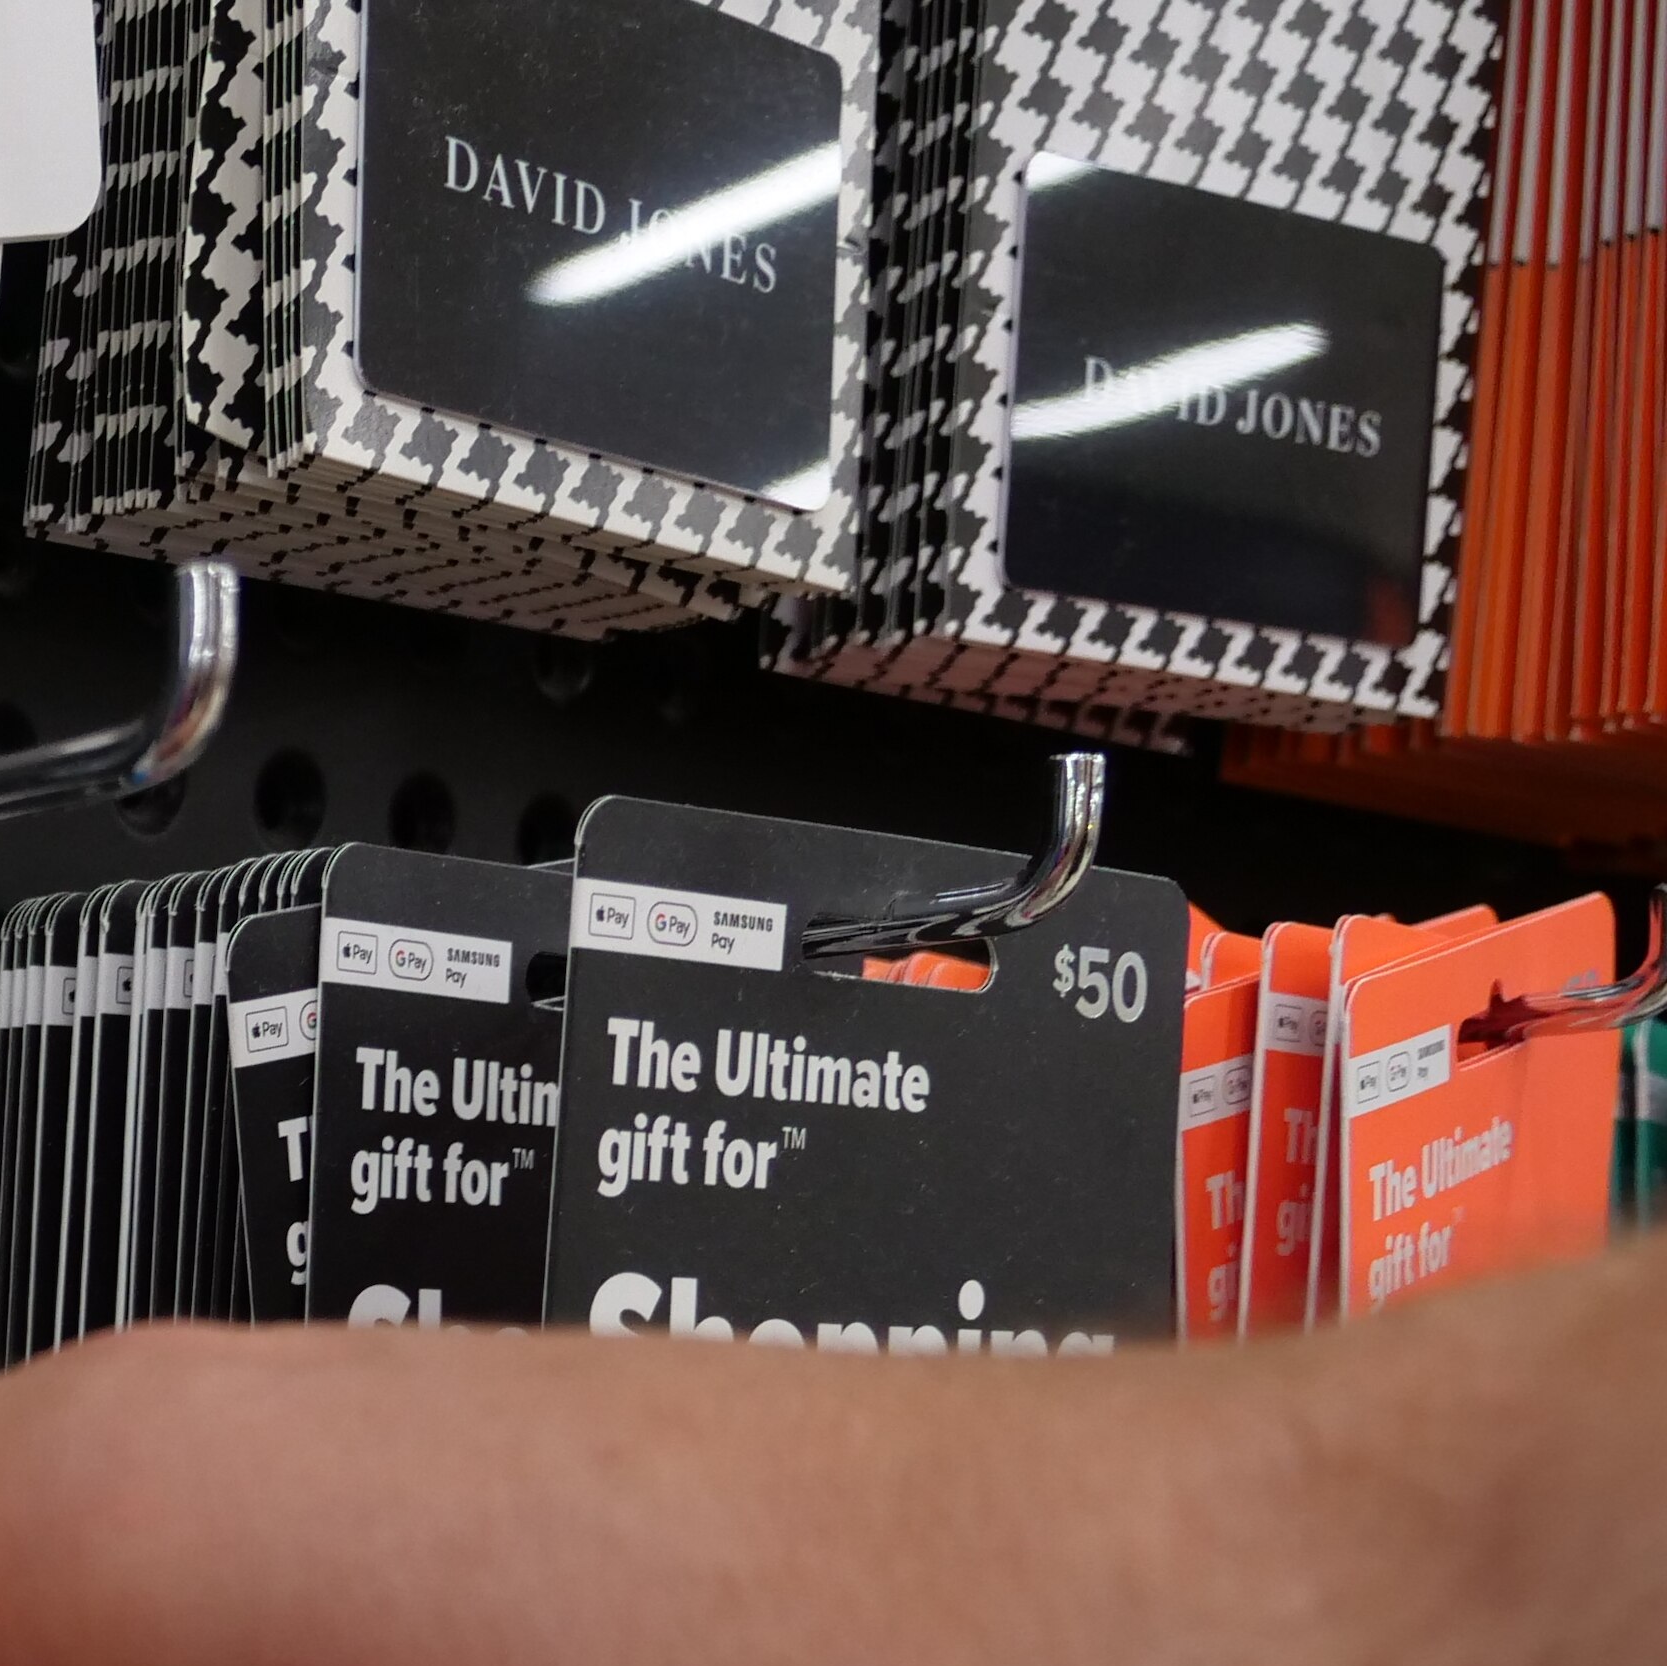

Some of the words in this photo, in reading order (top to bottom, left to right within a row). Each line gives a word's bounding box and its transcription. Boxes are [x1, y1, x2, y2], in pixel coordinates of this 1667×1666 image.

[443, 135, 606, 235] DAVID
[1084, 355, 1227, 428] DID
[1236, 391, 1383, 458] JONES
[606, 907, 630, 930] Pay
[668, 914, 691, 937] Pay
[710, 933, 736, 954] Pay
[712, 910, 774, 934] SAMSUNG
[352, 943, 373, 965] Pay
[407, 954, 427, 975] Pay
[445, 967, 468, 988] Pay
[446, 947, 501, 968] SAMSUNG
[1052, 944, 1148, 1023] $50
[261, 1019, 284, 1039] Pay
[356, 1047, 440, 1117] The
[607, 1016, 701, 1093] The
[714, 1028, 930, 1113] Ultimate
[597, 1113, 691, 1198] gift
[702, 1121, 777, 1190] for
[1284, 1107, 1318, 1165] Th
[1369, 1160, 1416, 1221] The
[1422, 1115, 1513, 1200] Ultimate
[350, 1135, 433, 1214] gift
[443, 1142, 509, 1206] for
[1206, 1171, 1244, 1231] Th
[1277, 1189, 1313, 1257] gi
[1208, 1243, 1238, 1322] gi
[1369, 1231, 1415, 1301] gift
[1419, 1220, 1452, 1274] for
